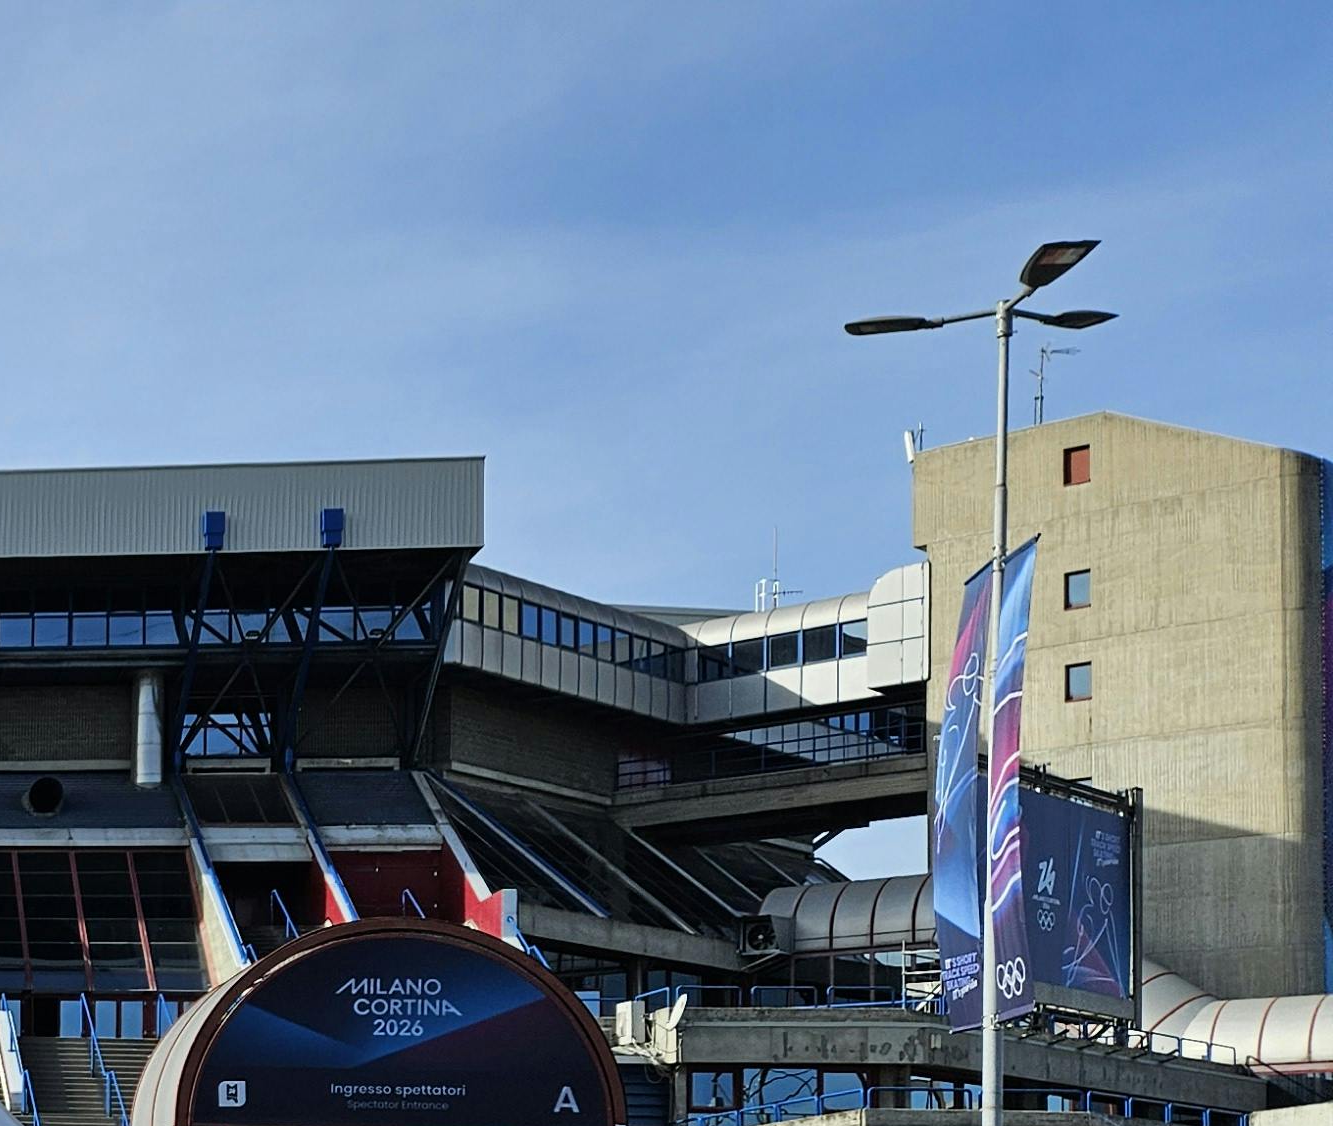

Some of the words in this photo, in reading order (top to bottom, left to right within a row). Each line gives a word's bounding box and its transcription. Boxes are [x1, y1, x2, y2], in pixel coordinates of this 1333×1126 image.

[335, 978, 442, 995] MILANO
[353, 998, 463, 1016] CORTINA
[373, 1019, 424, 1036] 2026
[330, 1083, 392, 1097] Ingresso
[395, 1084, 466, 1098] spettatori
[553, 1086, 580, 1113] A
